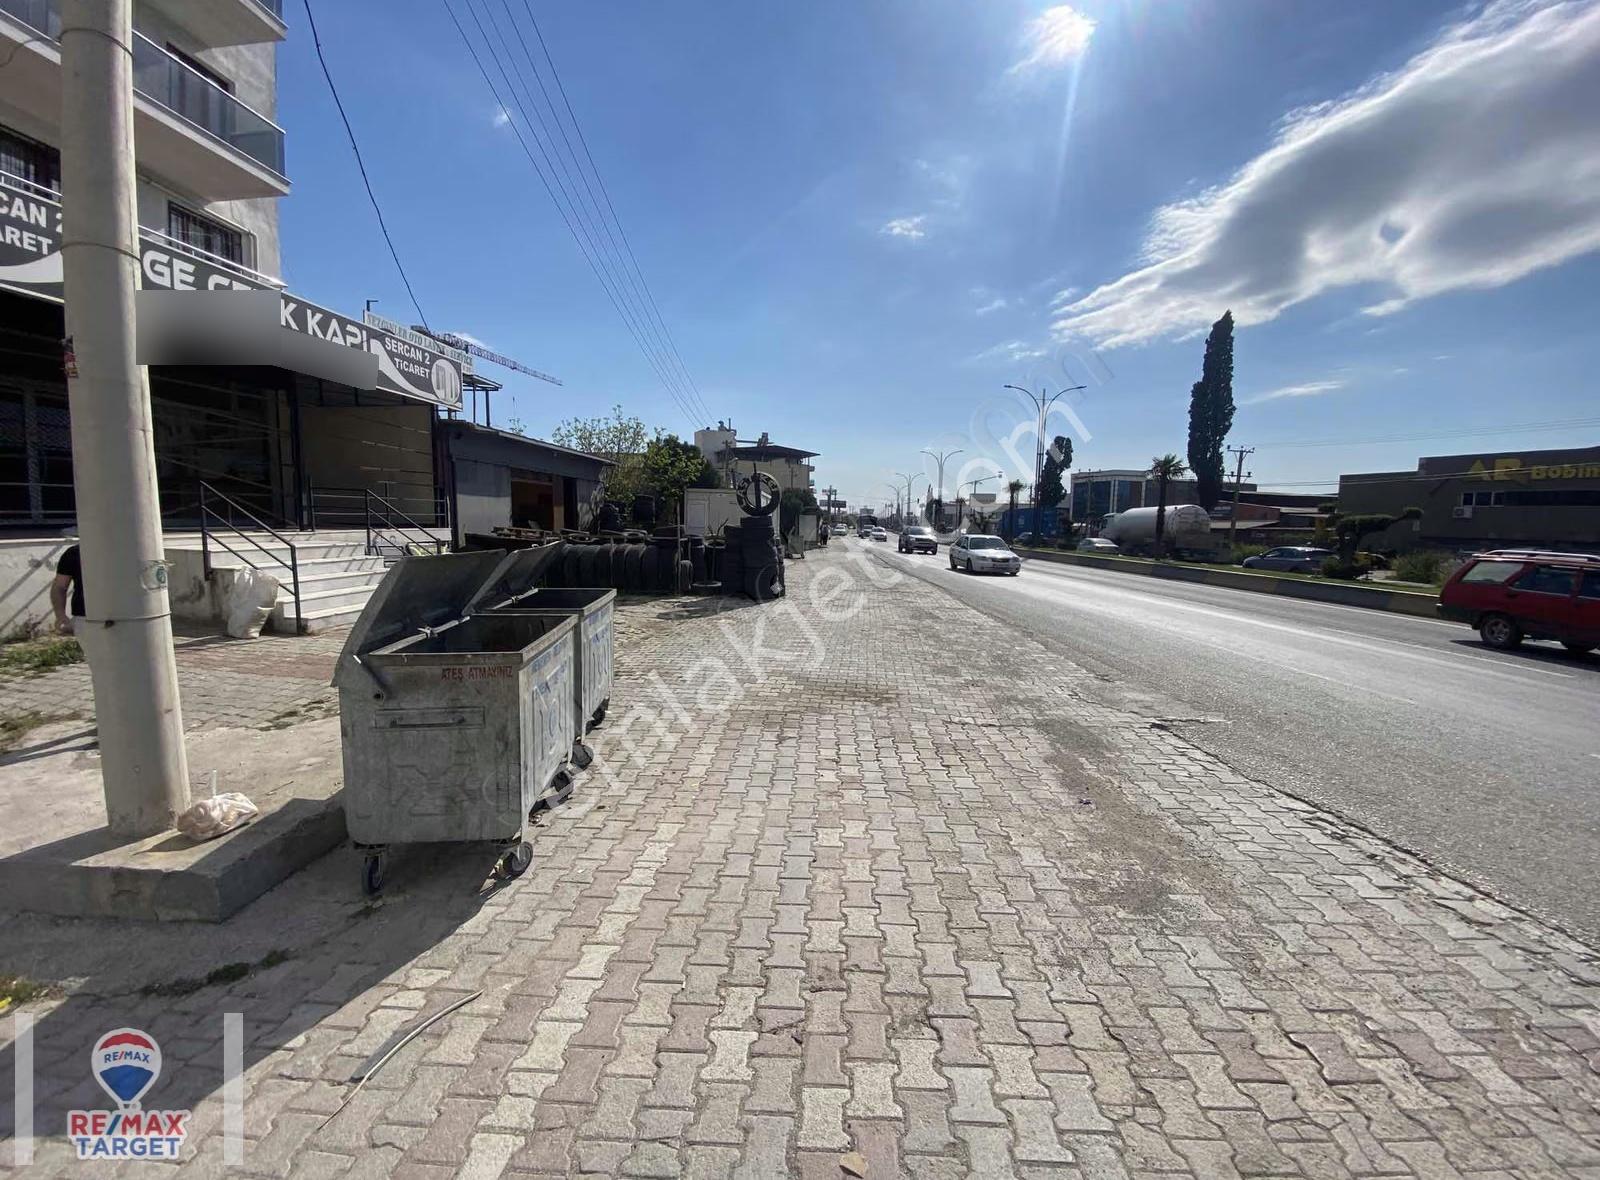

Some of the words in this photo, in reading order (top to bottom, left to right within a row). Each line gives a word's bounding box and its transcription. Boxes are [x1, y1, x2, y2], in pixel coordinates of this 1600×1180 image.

[306, 308, 368, 352] KAPI
[385, 337, 423, 362] SERCAN
[424, 353, 431, 365] 2
[394, 357, 430, 379] TİCARET
[441, 667, 463, 682] ATEŞ
[469, 665, 513, 680] ATMAYINIZ
